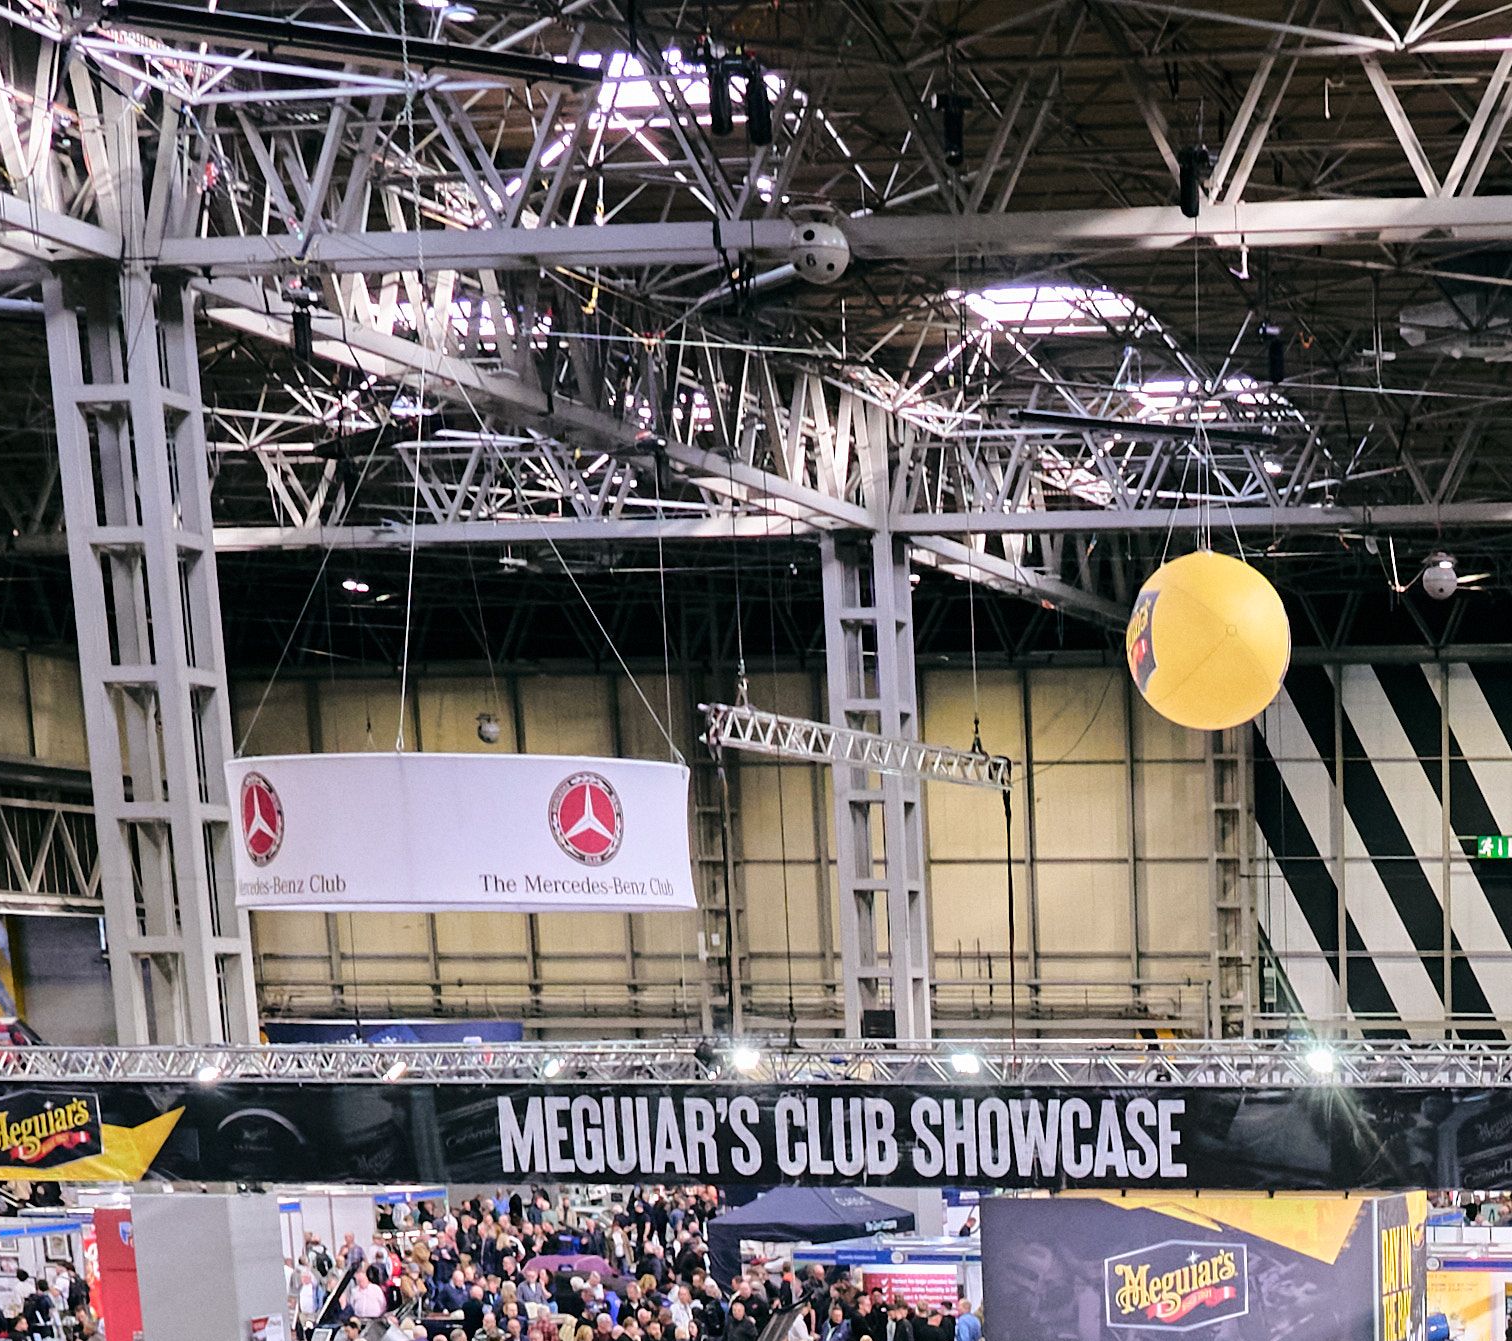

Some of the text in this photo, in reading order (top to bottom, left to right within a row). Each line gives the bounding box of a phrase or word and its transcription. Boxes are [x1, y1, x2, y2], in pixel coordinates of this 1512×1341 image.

[309, 873, 346, 893] Club
[479, 874, 674, 896] The Mercedes-Benz Club
[496, 1095, 1188, 1179] MEGUIAR'S CLUB SHOWCASE
[1114, 1249, 1238, 1318] Meguiar's
